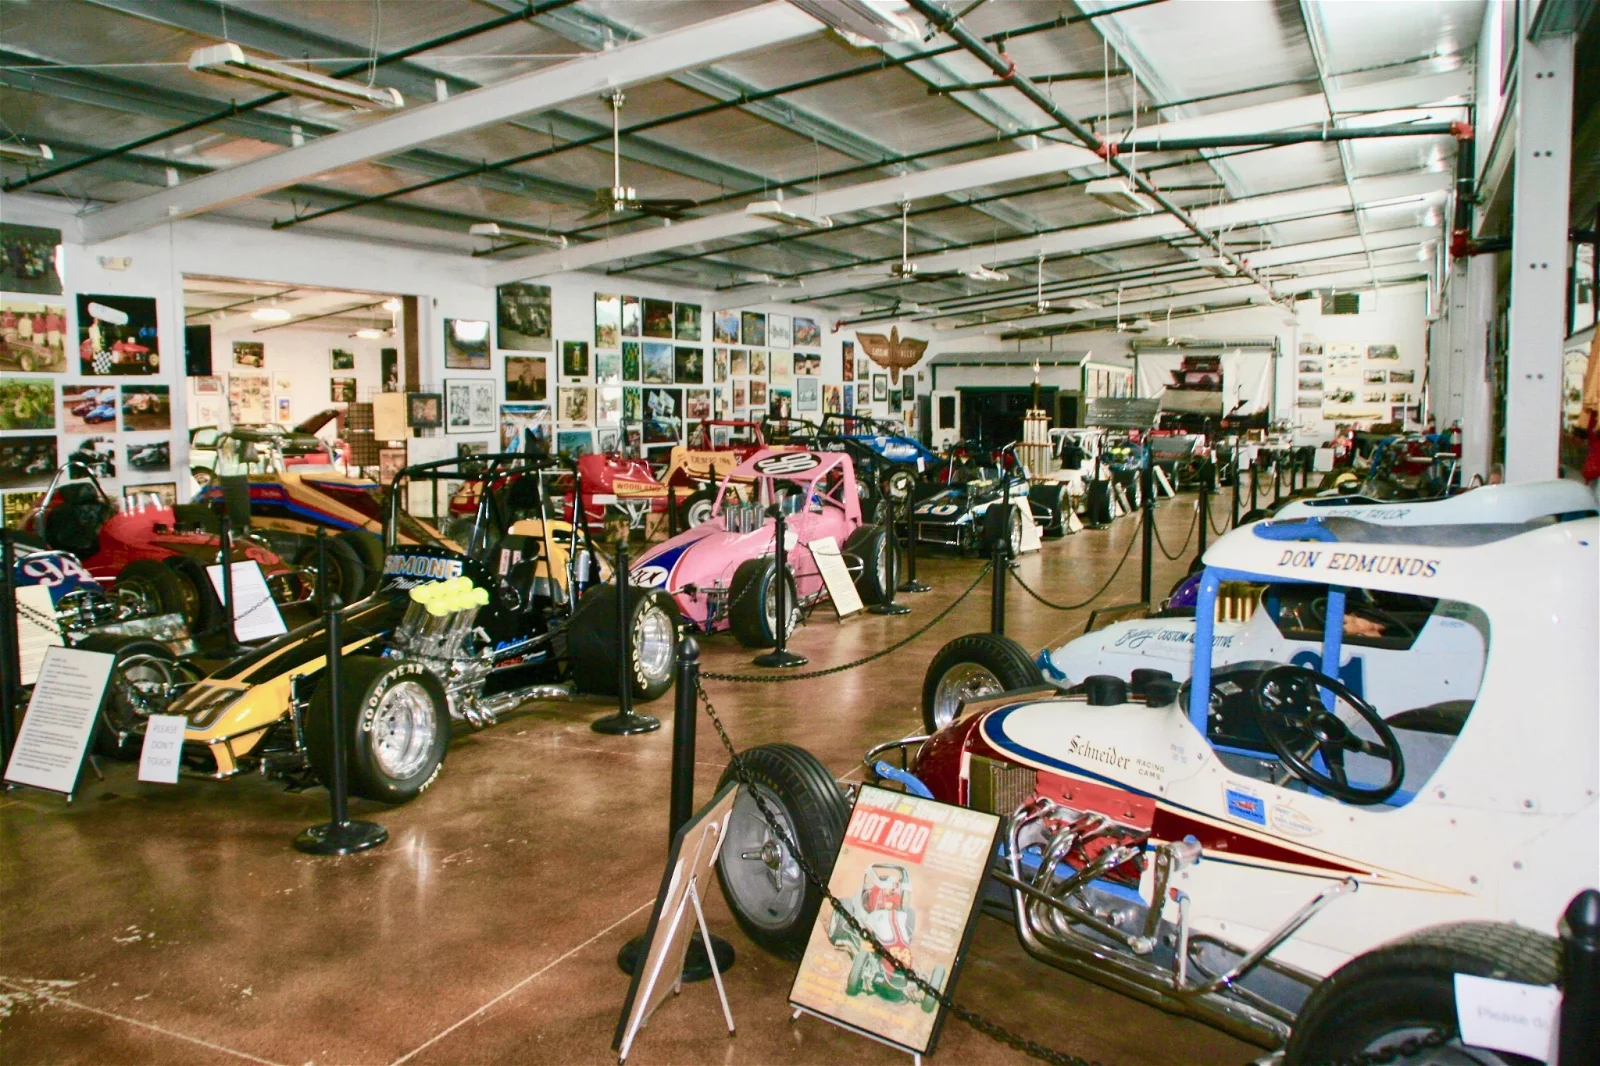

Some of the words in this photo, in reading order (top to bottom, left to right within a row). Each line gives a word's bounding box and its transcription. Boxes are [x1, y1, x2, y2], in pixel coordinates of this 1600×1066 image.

[23, 557, 96, 588] 94
[1277, 549, 1322, 568] DON
[1326, 552, 1440, 578] EDMUNDS
[1157, 629, 1190, 642] CUSTOM
[362, 663, 424, 732] GOODYEAR
[152, 725, 178, 734] PLEASE
[1068, 735, 1131, 770] Schneider
[1136, 758, 1165, 773] RACING
[1138, 769, 1161, 780] CAMS
[847, 810, 890, 843] HOT
[884, 819, 930, 854] ROD
